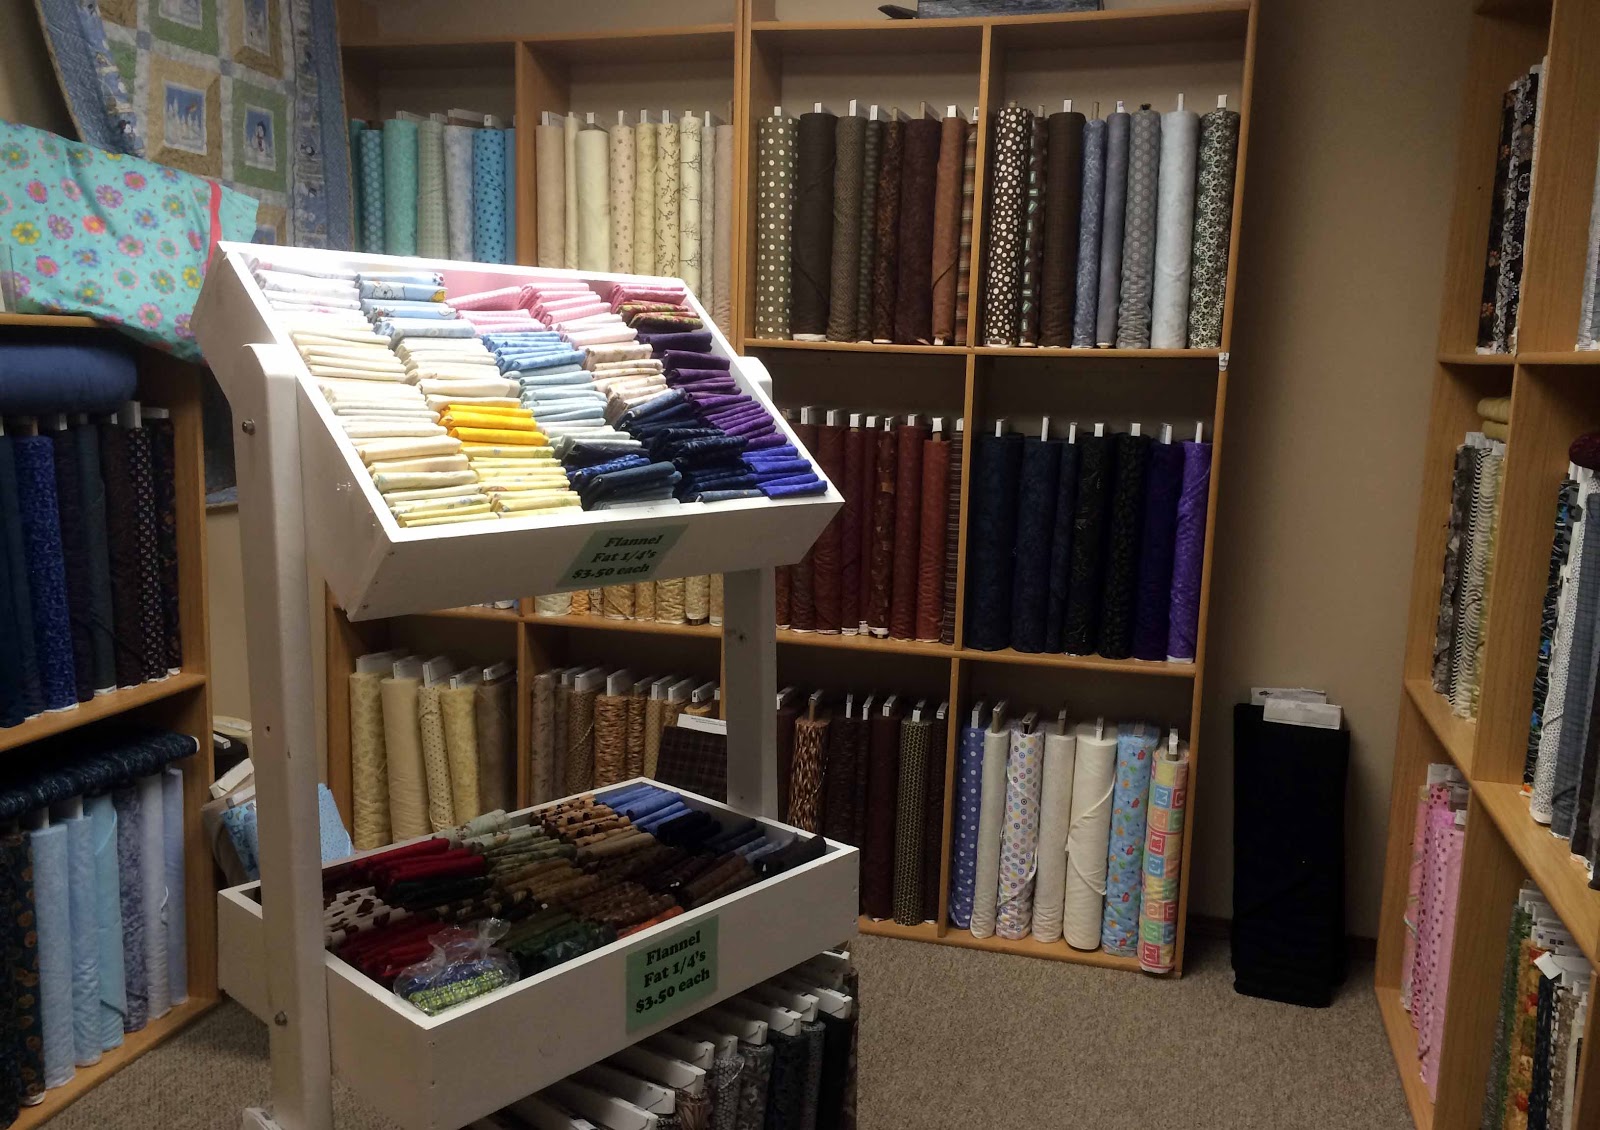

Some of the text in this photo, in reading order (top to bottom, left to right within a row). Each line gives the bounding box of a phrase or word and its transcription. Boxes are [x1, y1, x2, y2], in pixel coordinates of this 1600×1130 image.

[604, 534, 664, 547] Flannel
[591, 549, 657, 563] Fat 1/4's
[572, 563, 650, 579] $3.50 each
[646, 930, 701, 966] Flannel
[644, 951, 706, 988] Fat 1/4's
[635, 968, 710, 1013] $3.50 each
